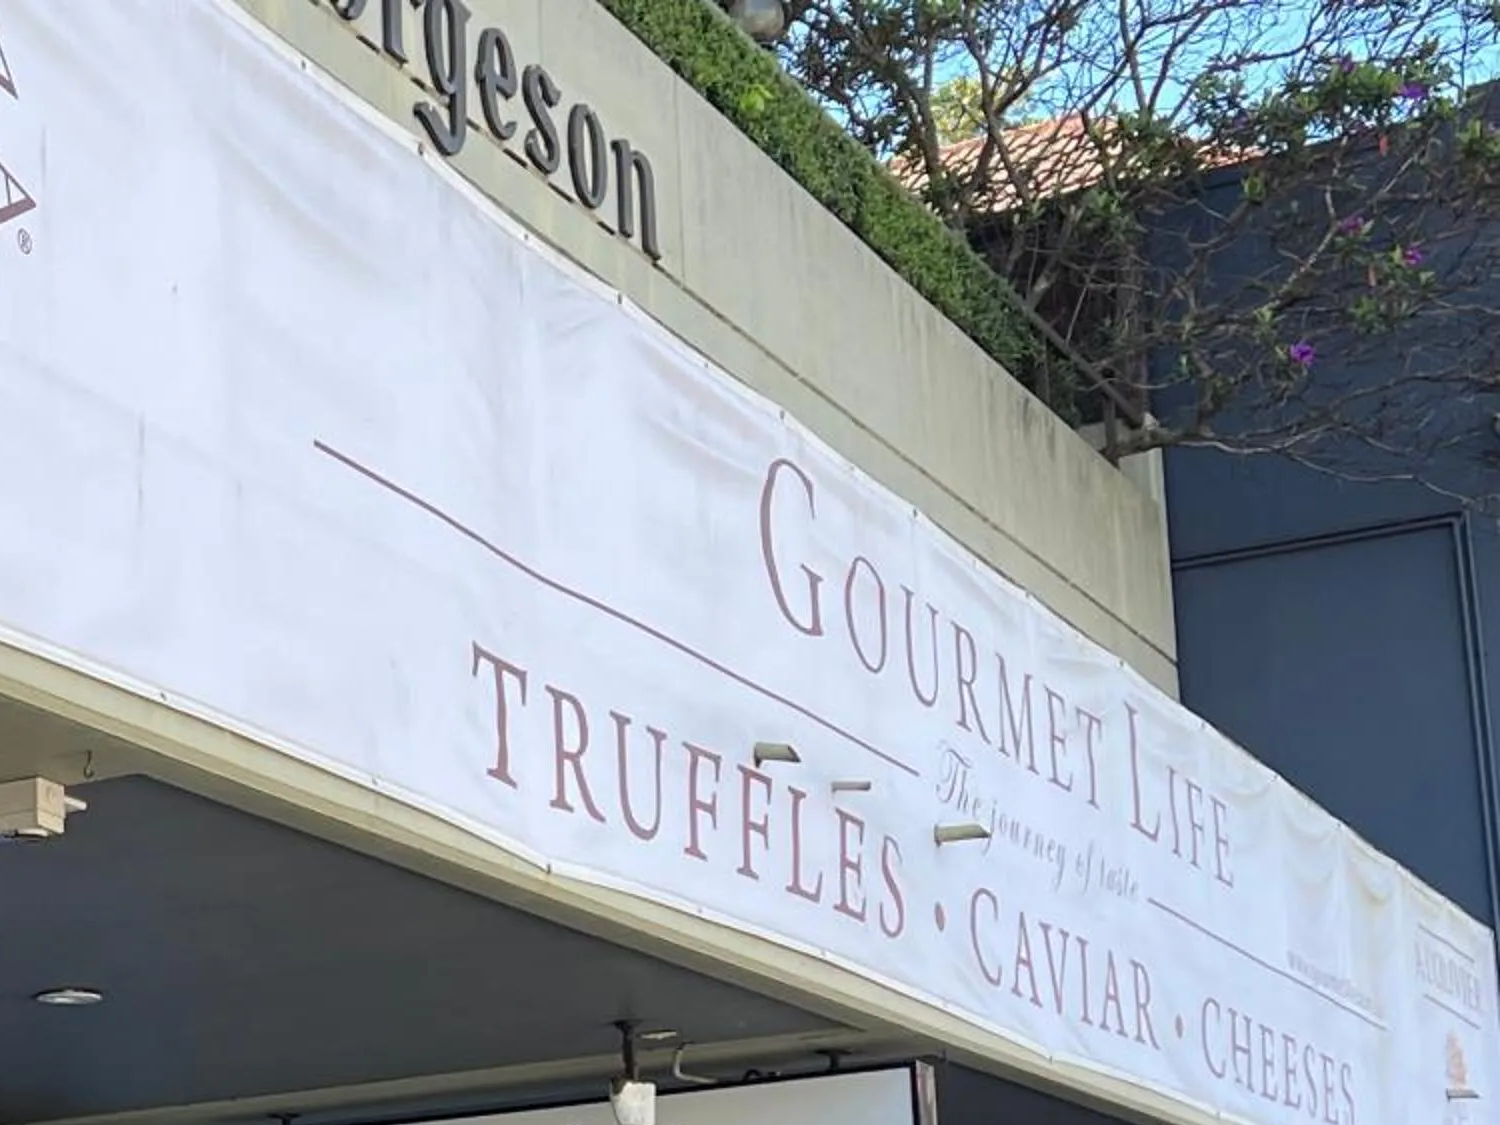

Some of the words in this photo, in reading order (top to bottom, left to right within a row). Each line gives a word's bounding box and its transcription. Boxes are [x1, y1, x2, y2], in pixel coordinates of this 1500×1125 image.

[334, 0, 662, 262] rgeson
[472, 641, 902, 938] TRUFFLES
[759, 458, 1102, 809] GOURMET
[1123, 701, 1235, 888] LIFE
[969, 888, 1161, 1051] CAVIAR
